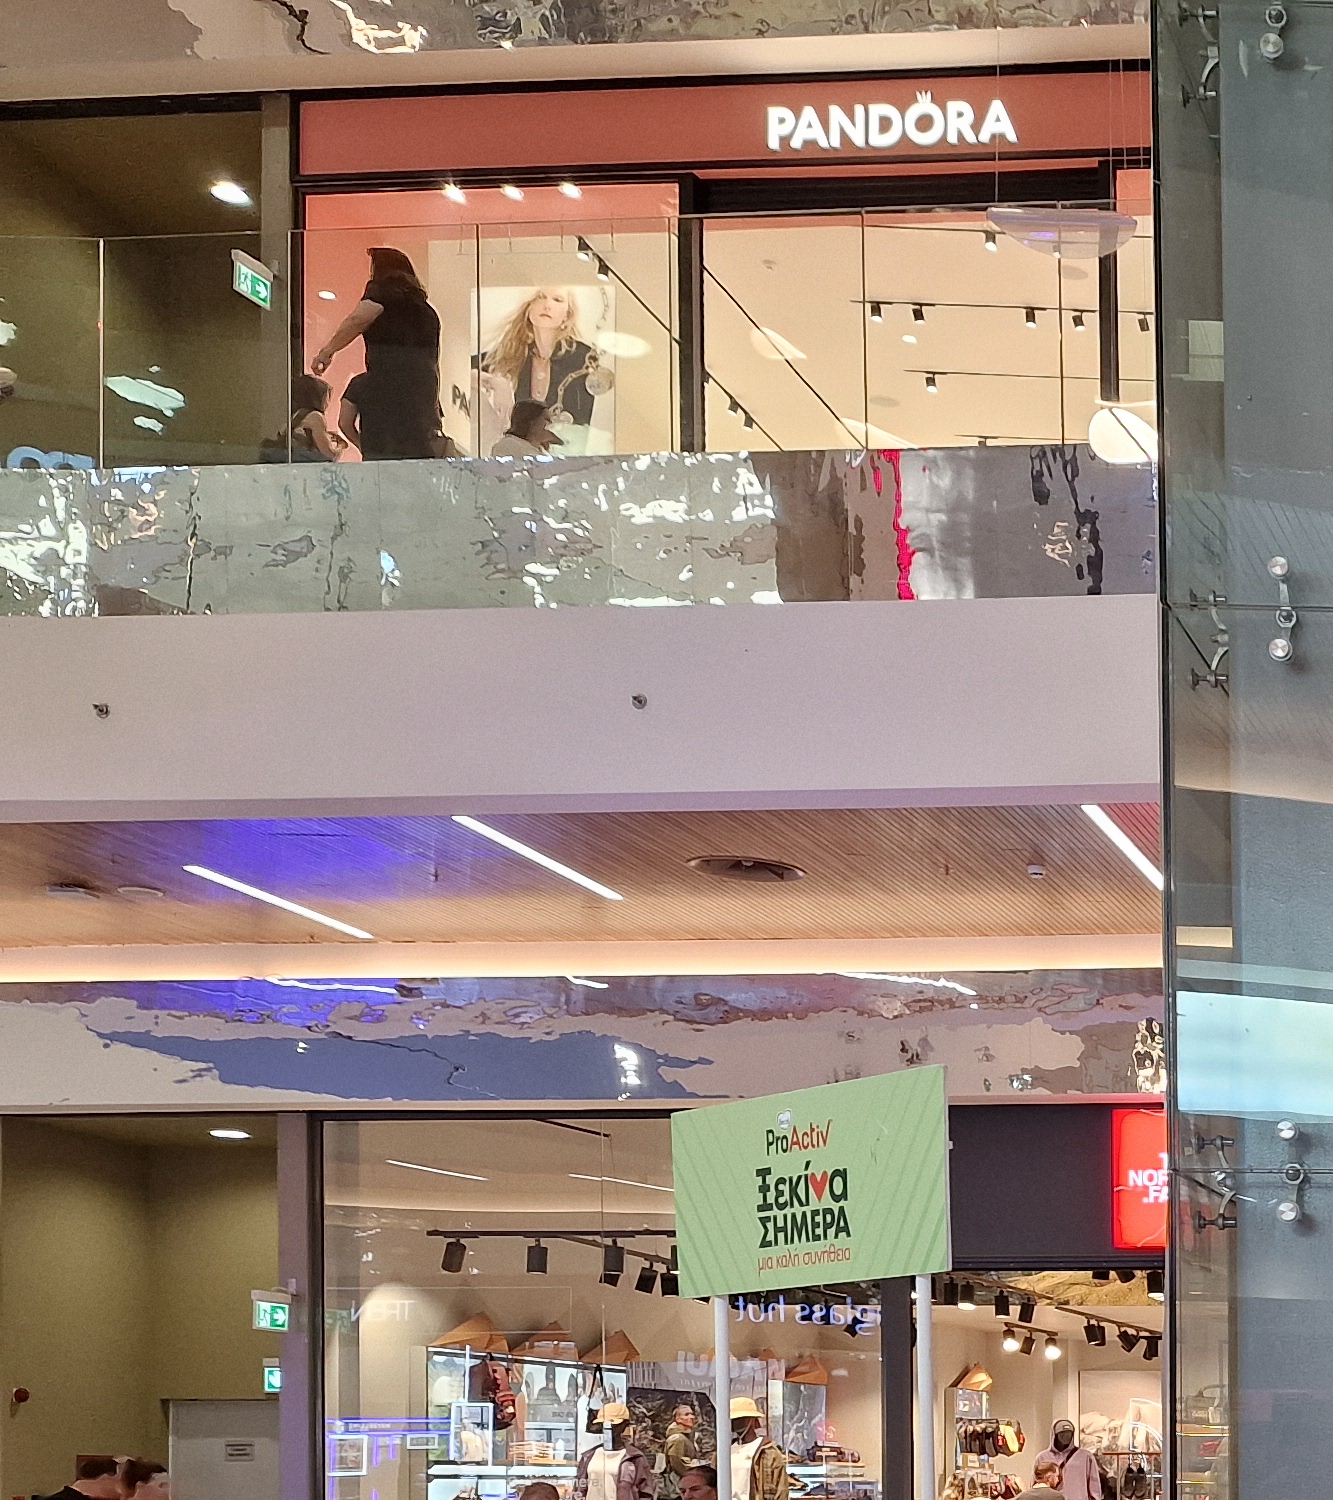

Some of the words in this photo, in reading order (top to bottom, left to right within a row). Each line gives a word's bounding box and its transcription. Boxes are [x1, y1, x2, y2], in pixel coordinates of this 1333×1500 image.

[765, 90, 1018, 151] PANDORA
[757, 1205, 851, 1249] ΣΗΜΕΡΑ
[758, 1256, 773, 1276] μια
[776, 1247, 800, 1270] καλή
[802, 1243, 851, 1266] συνήθεια
